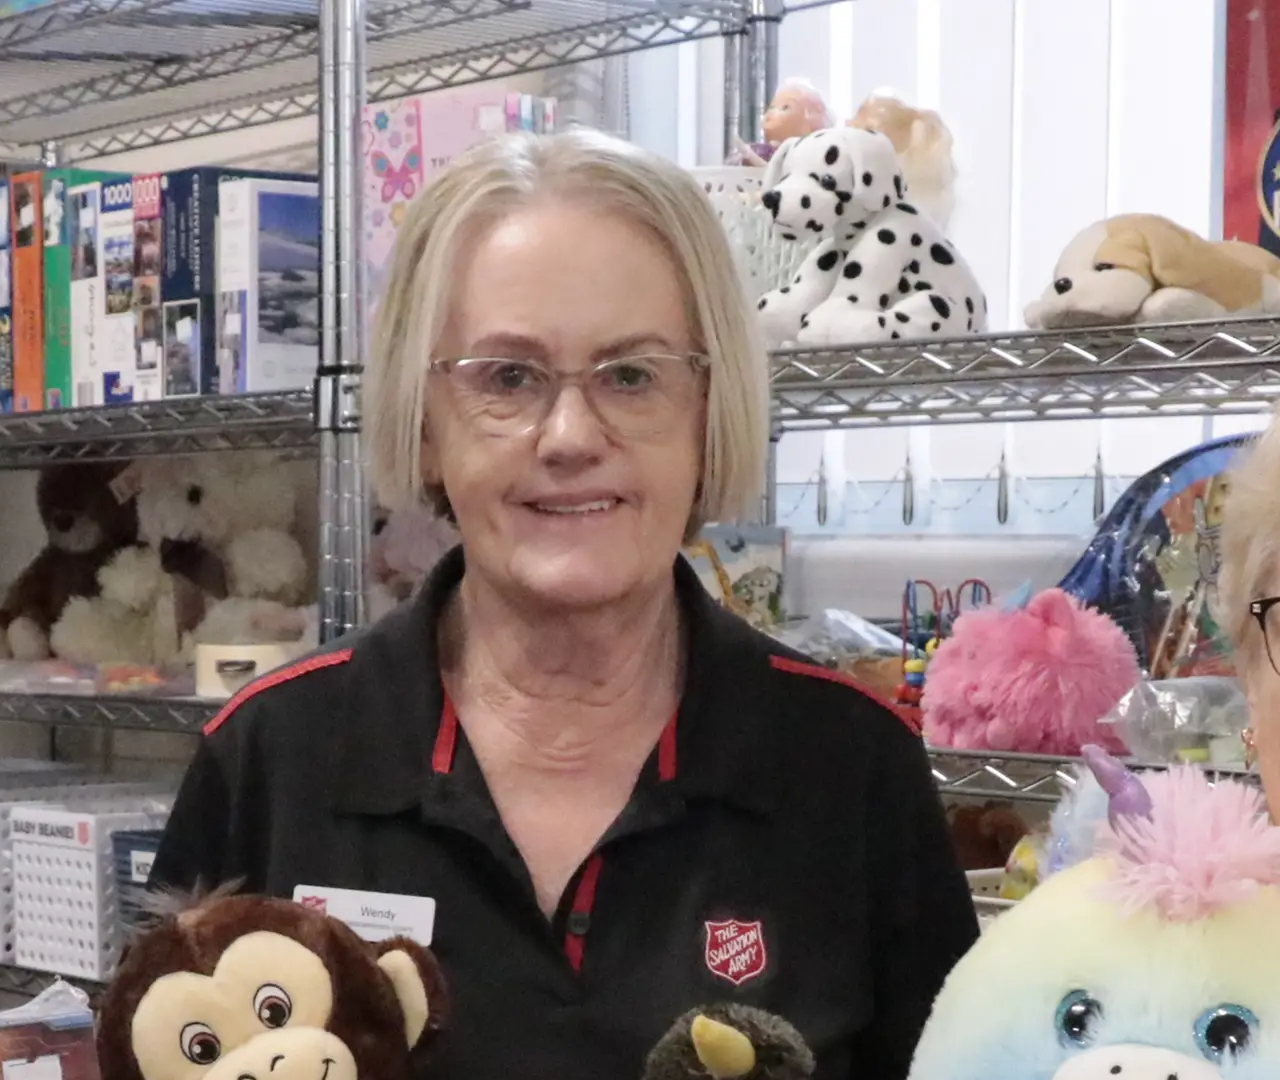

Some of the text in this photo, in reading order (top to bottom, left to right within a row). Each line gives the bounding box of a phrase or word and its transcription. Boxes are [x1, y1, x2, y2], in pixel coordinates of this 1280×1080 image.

[104, 183, 132, 205] 1000
[12, 819, 36, 834] BABY
[360, 905, 396, 921] Wendy
[714, 924, 739, 943] THE
[709, 927, 758, 967] SALVATION
[728, 945, 757, 976] ARMY
